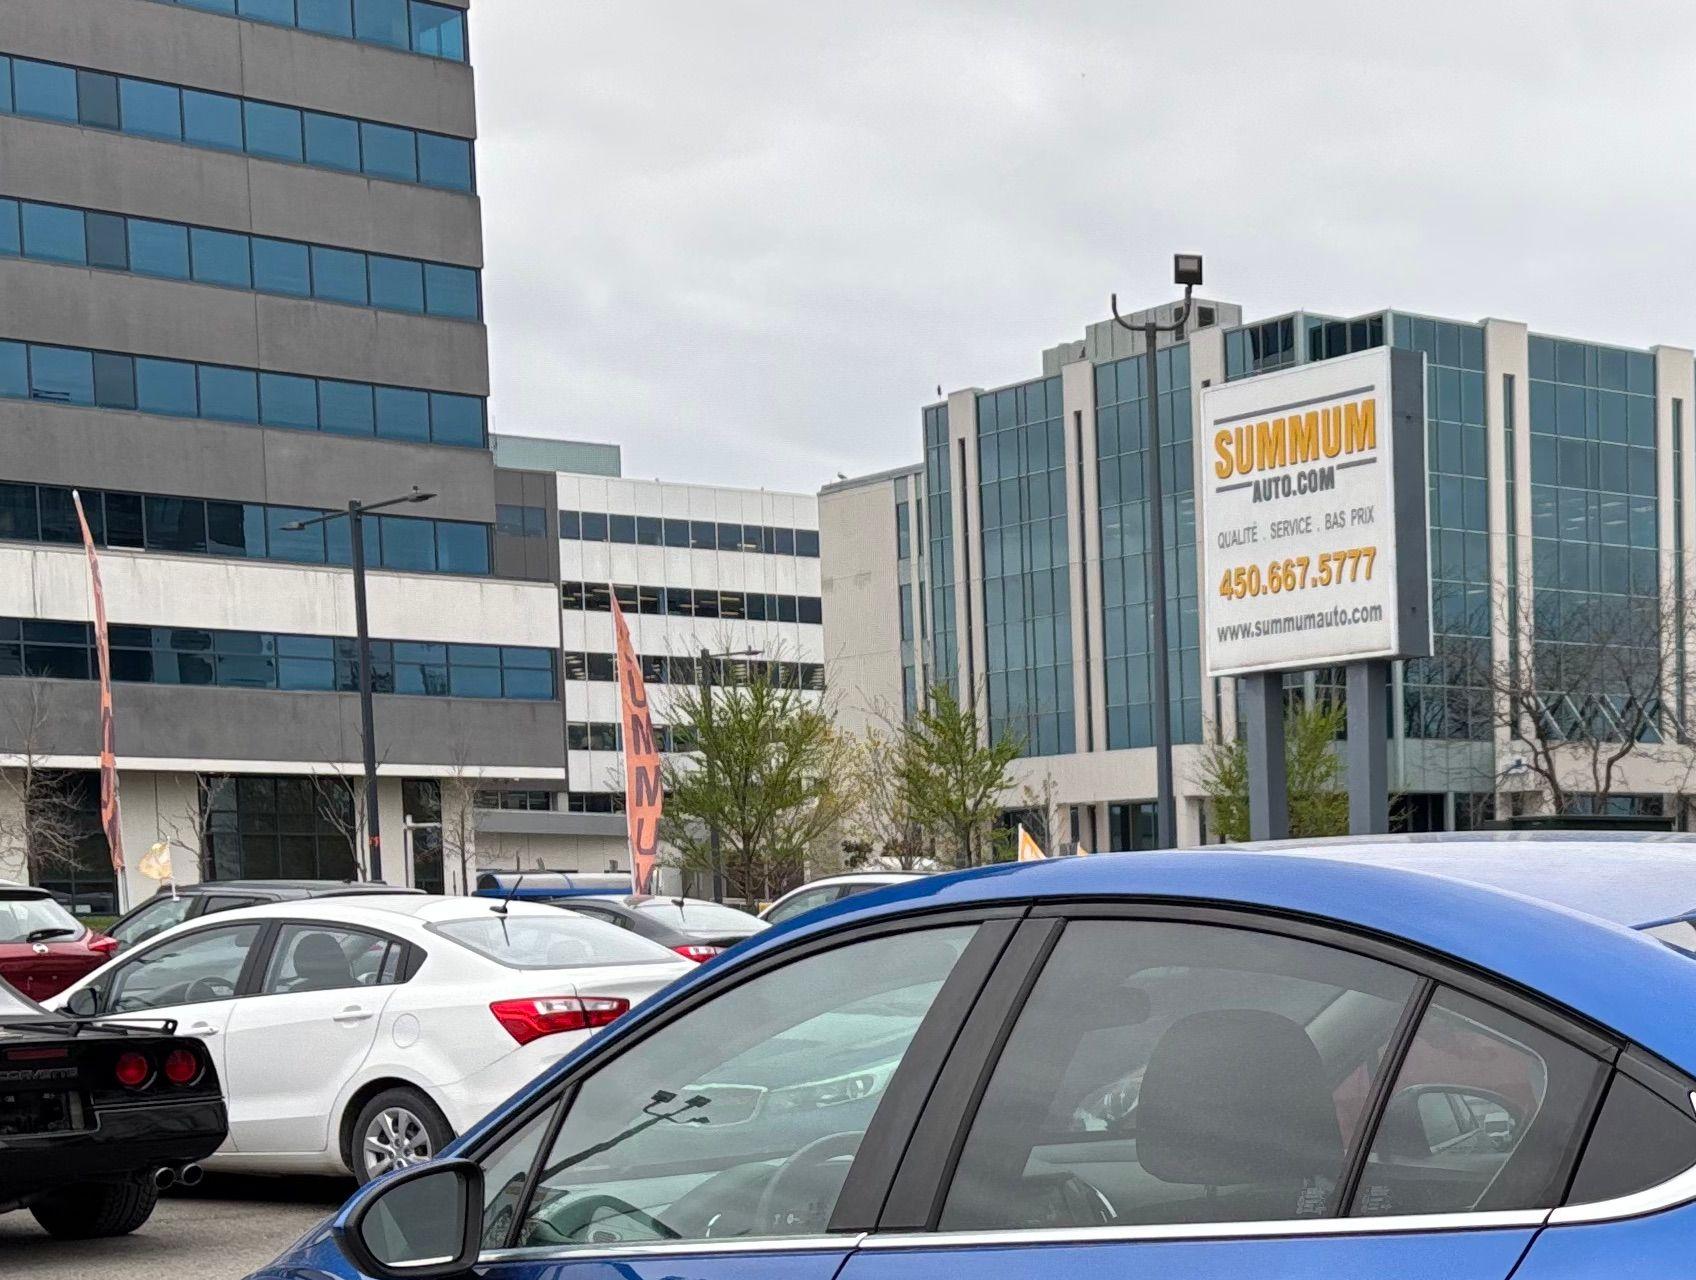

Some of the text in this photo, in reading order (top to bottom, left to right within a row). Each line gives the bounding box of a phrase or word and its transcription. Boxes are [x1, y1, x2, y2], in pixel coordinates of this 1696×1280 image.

[1214, 399, 1377, 480] SUMMUM
[1252, 465, 1336, 503] AUTO.COM
[1270, 515, 1312, 540] SERVICE
[1325, 510, 1346, 531] BAS
[1351, 505, 1375, 524] PRIX
[1218, 546, 1377, 601] 450.667.5777
[1217, 604, 1382, 643] www.summumauto.com
